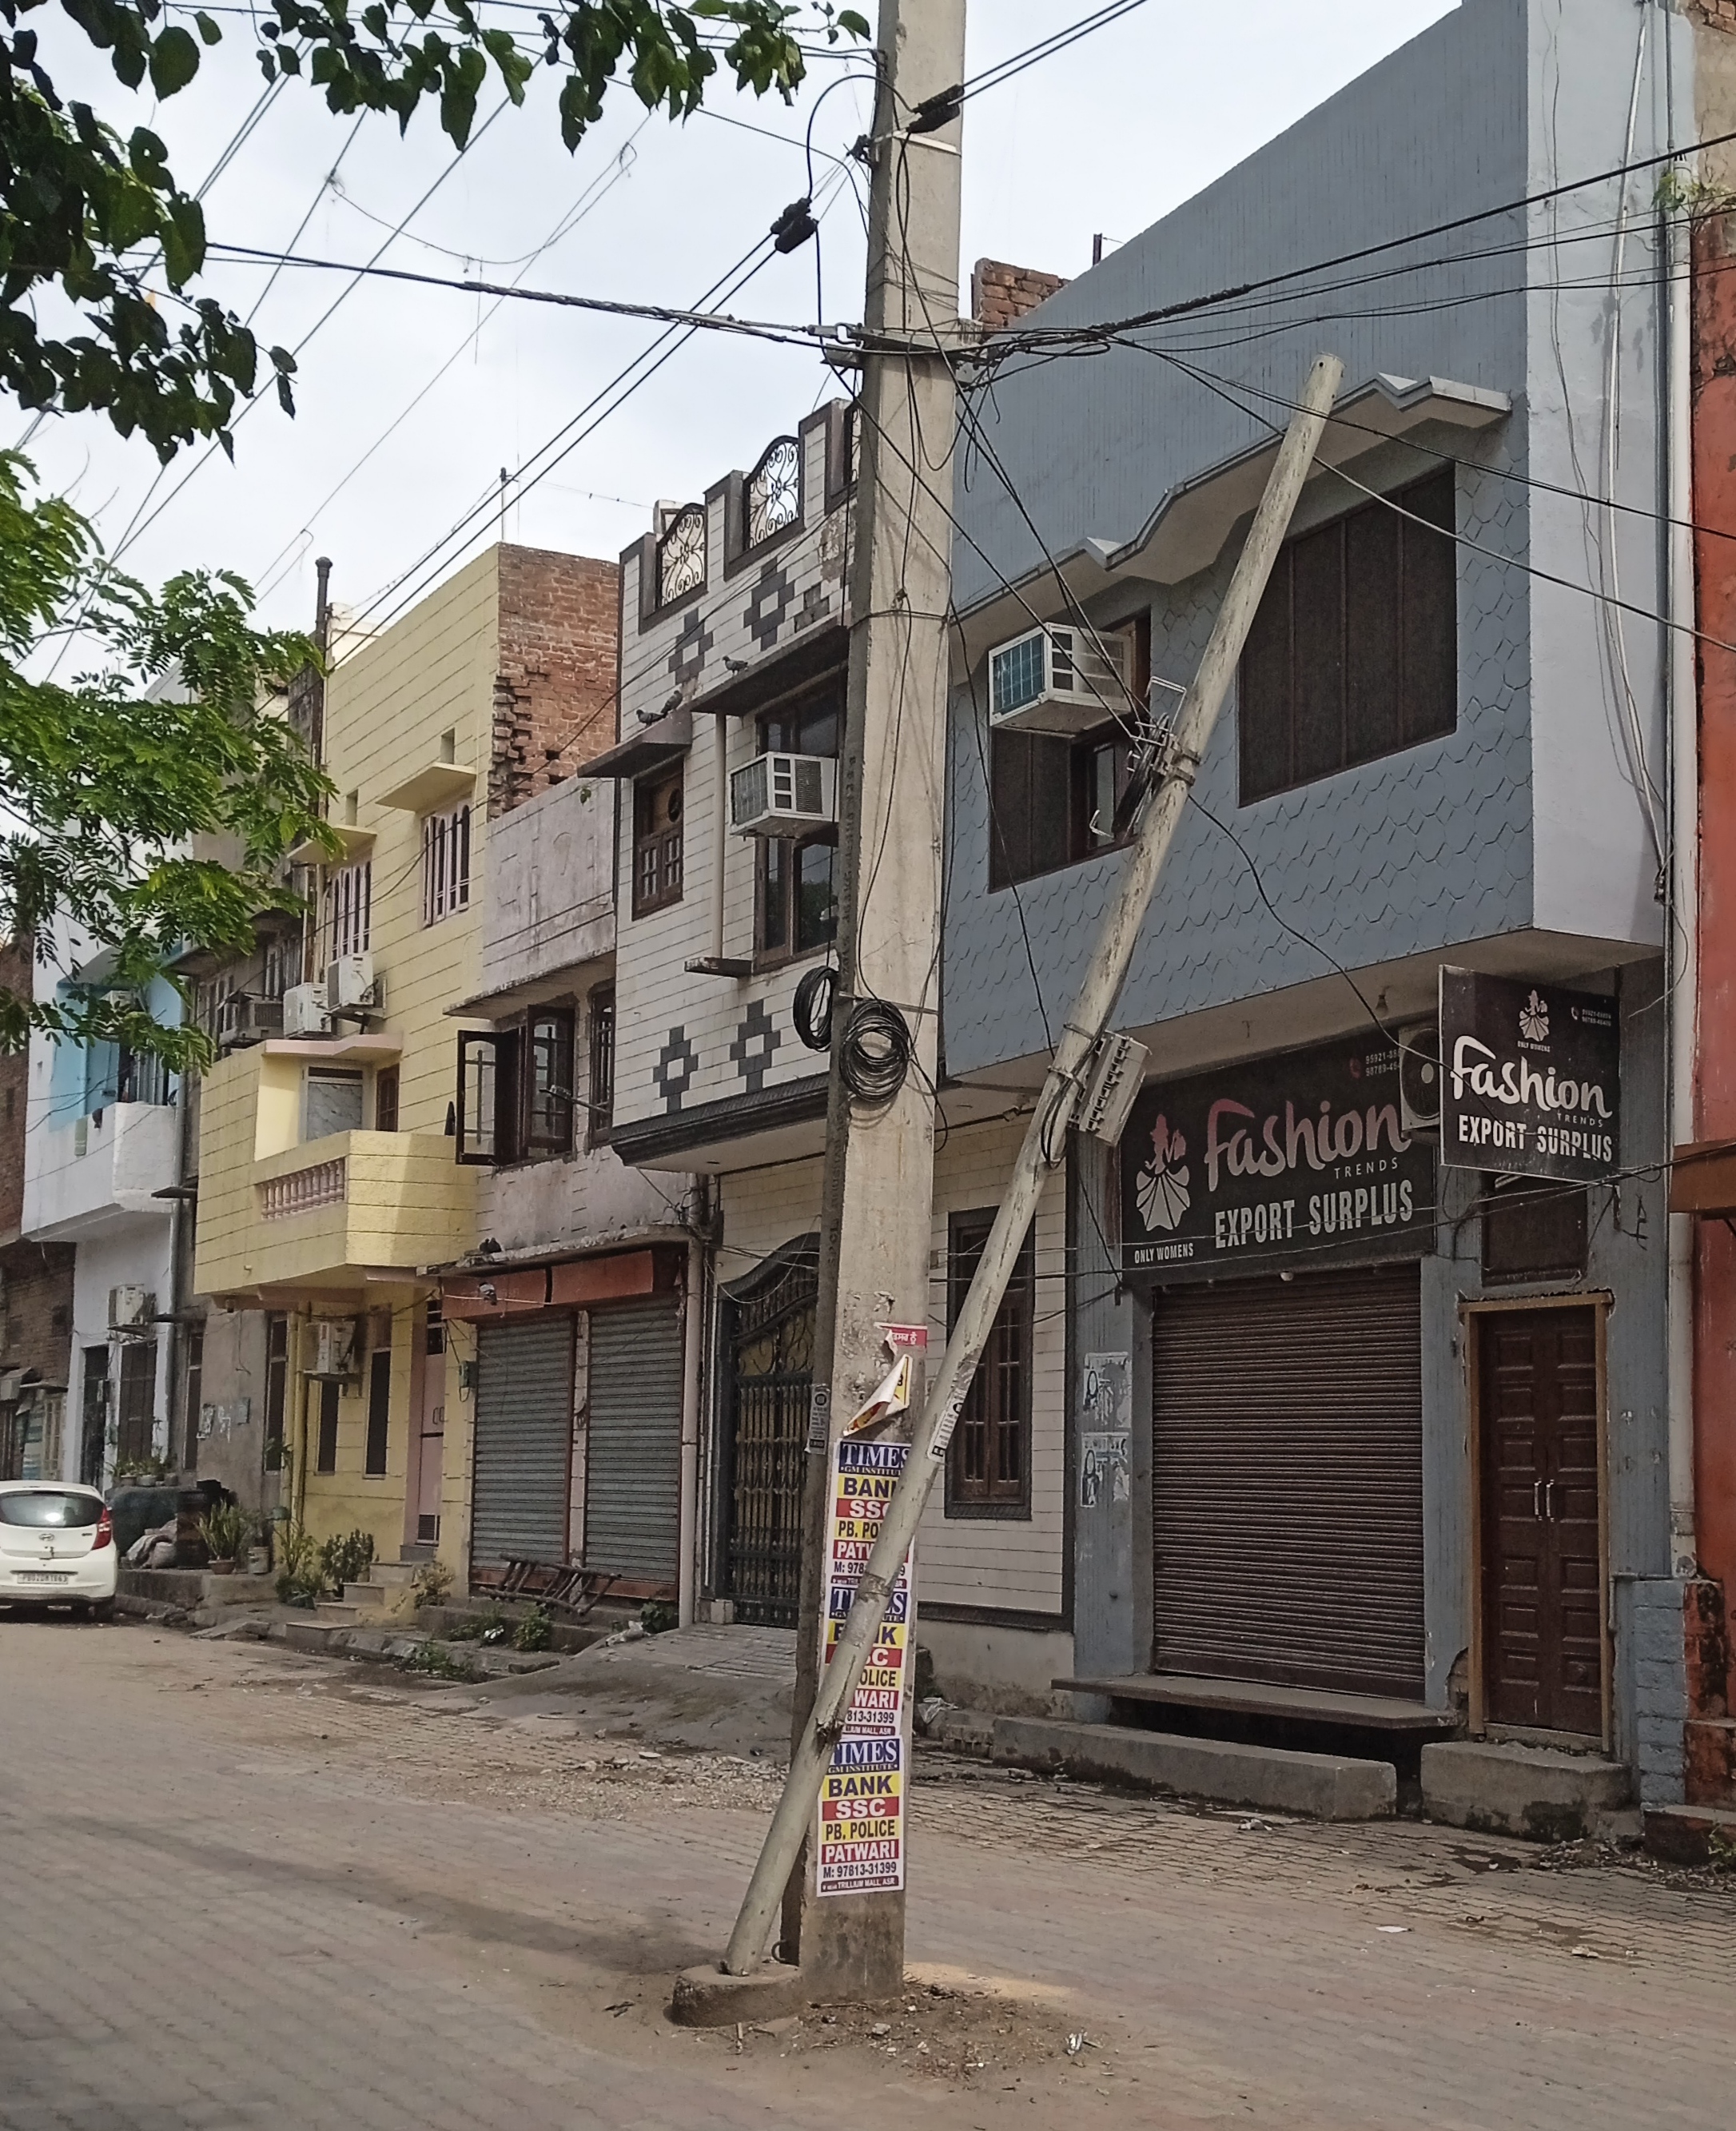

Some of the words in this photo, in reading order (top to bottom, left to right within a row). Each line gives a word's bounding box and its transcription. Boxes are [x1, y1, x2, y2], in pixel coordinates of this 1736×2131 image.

[1450, 1035, 1613, 1118] Fashion
[1558, 1113, 1603, 1128] TRENDS
[1204, 1098, 1411, 1191] Fashion
[1459, 1114, 1527, 1149] EXPORT
[1538, 1125, 1612, 1162] SURPLUS
[1334, 1157, 1397, 1179] TRENDS
[1215, 1201, 1295, 1248] EXPORT
[1309, 1180, 1412, 1235] SURPLUS
[1134, 1248, 1154, 1263] ONLY
[1157, 1243, 1194, 1260] WOMENS
[843, 1477, 898, 1498] BAN
[849, 1500, 890, 1520] SS
[838, 1520, 858, 1537] PB.
[834, 1561, 845, 1573] M:
[828, 1775, 893, 1797] BANK
[835, 1798, 886, 1819] SSC
[826, 1822, 846, 1840] PB.
[850, 1819, 895, 1838] POLICE
[825, 1840, 895, 1863] PATWARI
[823, 1866, 834, 1878] M:
[837, 1862, 897, 1877] 97813-31399
